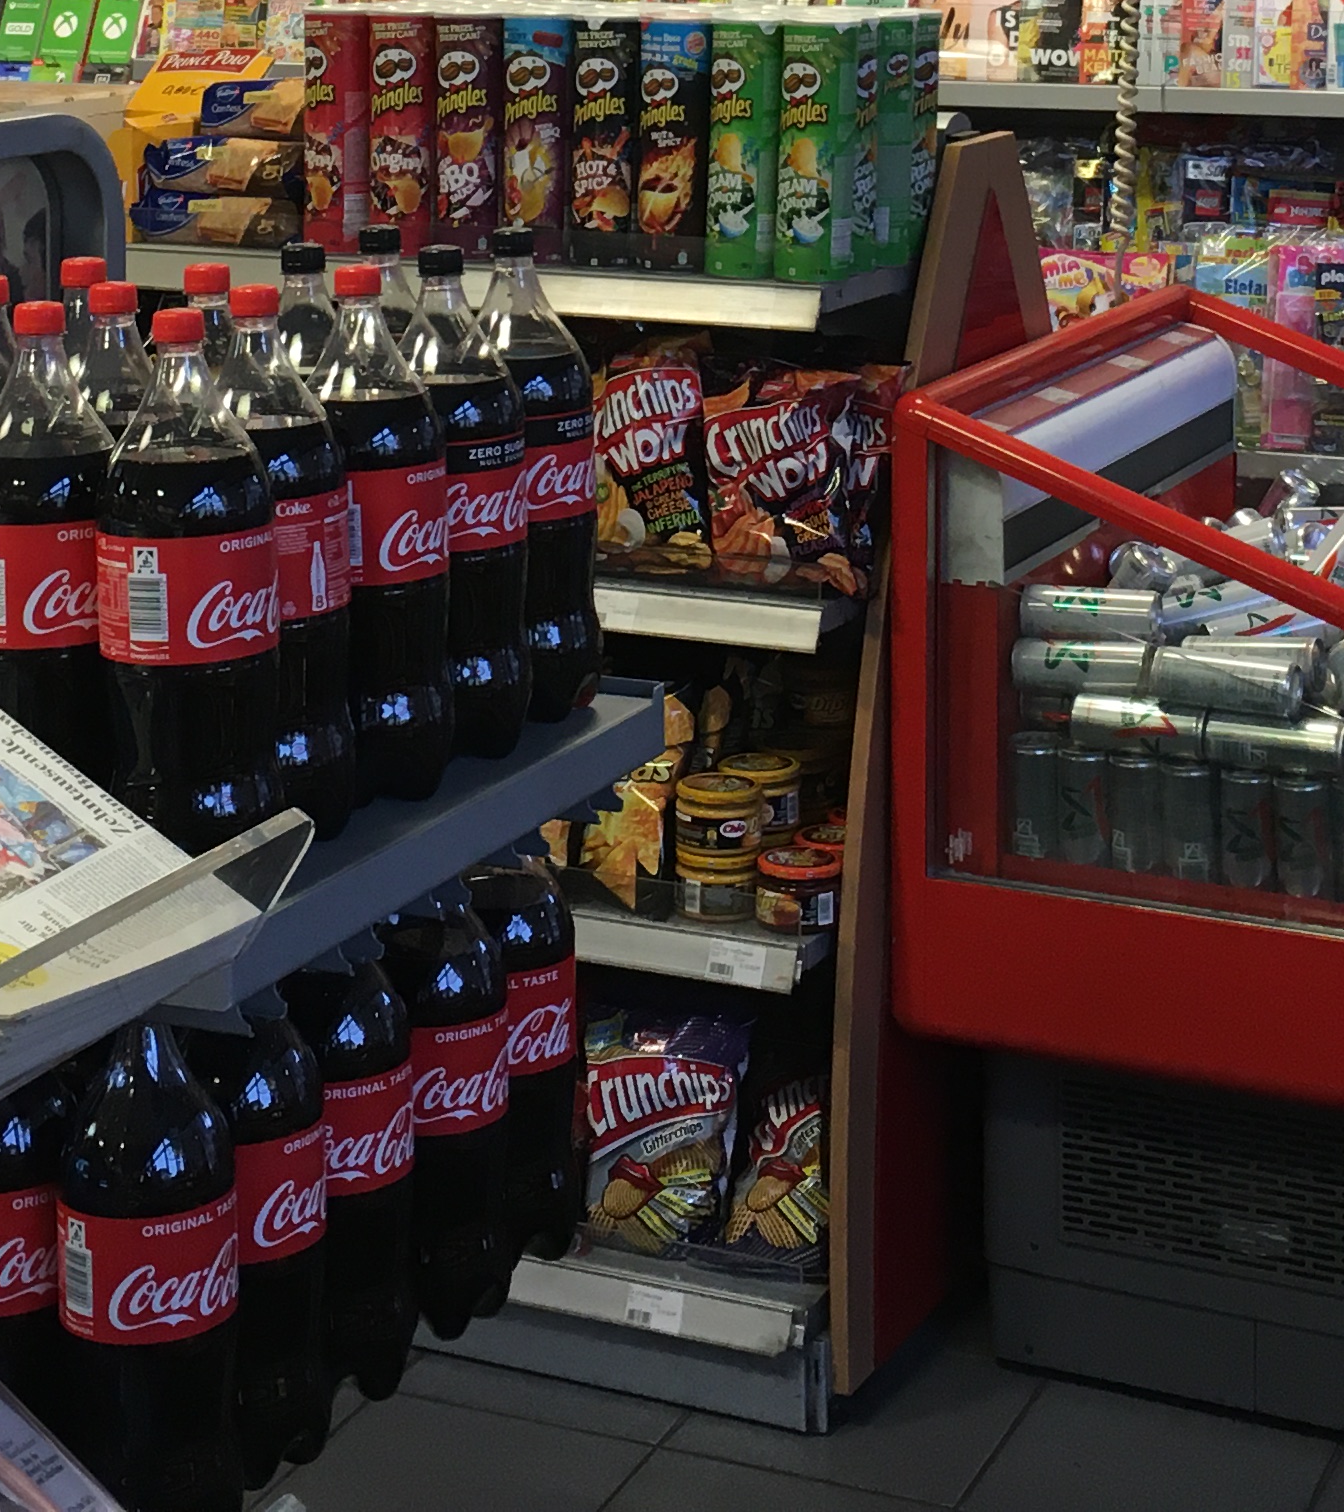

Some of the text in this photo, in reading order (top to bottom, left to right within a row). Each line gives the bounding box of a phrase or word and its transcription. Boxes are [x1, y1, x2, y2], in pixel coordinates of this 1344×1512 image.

[6, 22, 34, 33] GOLD
[161, 49, 249, 72] PRINCE POLO
[370, 84, 423, 116] Pringles
[437, 84, 487, 118] Pringles
[505, 94, 558, 125] Pringles
[574, 94, 625, 127] Pringles
[576, 160, 605, 180] HOT
[574, 176, 614, 198] SPICY
[609, 422, 687, 476] WOW
[706, 402, 822, 476] Crunchips
[469, 446, 502, 460] ZERO
[749, 443, 828, 501] WOW
[647, 512, 700, 533] INFERNO
[522, 970, 560, 989] TASTE
[435, 1024, 491, 1044] ORIGINAL
[587, 1069, 731, 1137] Crunchips
[642, 1122, 704, 1155] Gitterchips
[142, 1217, 216, 1238] ORIGINAL
